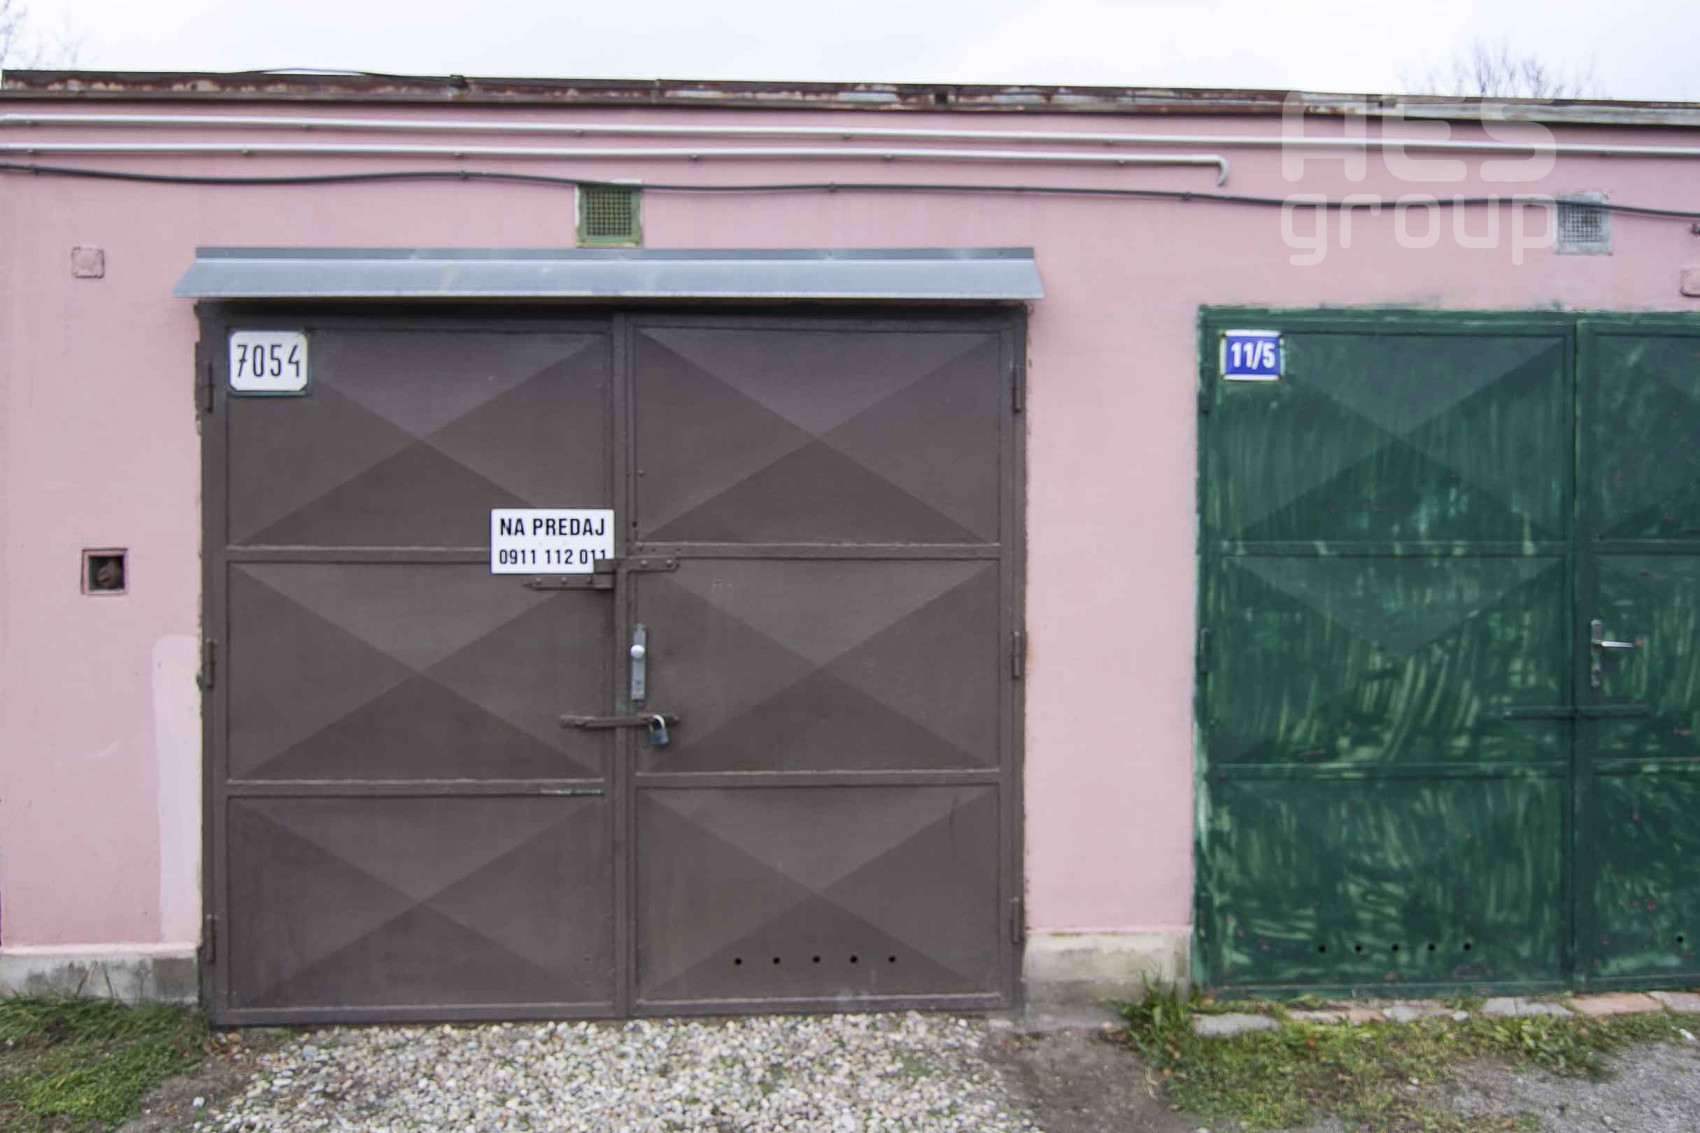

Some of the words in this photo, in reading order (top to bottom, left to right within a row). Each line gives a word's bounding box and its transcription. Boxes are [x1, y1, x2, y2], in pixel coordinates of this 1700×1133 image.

[237, 344, 300, 378] 7054
[1231, 340, 1276, 370] 11/5
[500, 518, 525, 536] NA
[533, 518, 605, 536] PREDAJ
[499, 549, 536, 565] 0911
[545, 549, 573, 565] 112
[579, 549, 606, 565] 011
